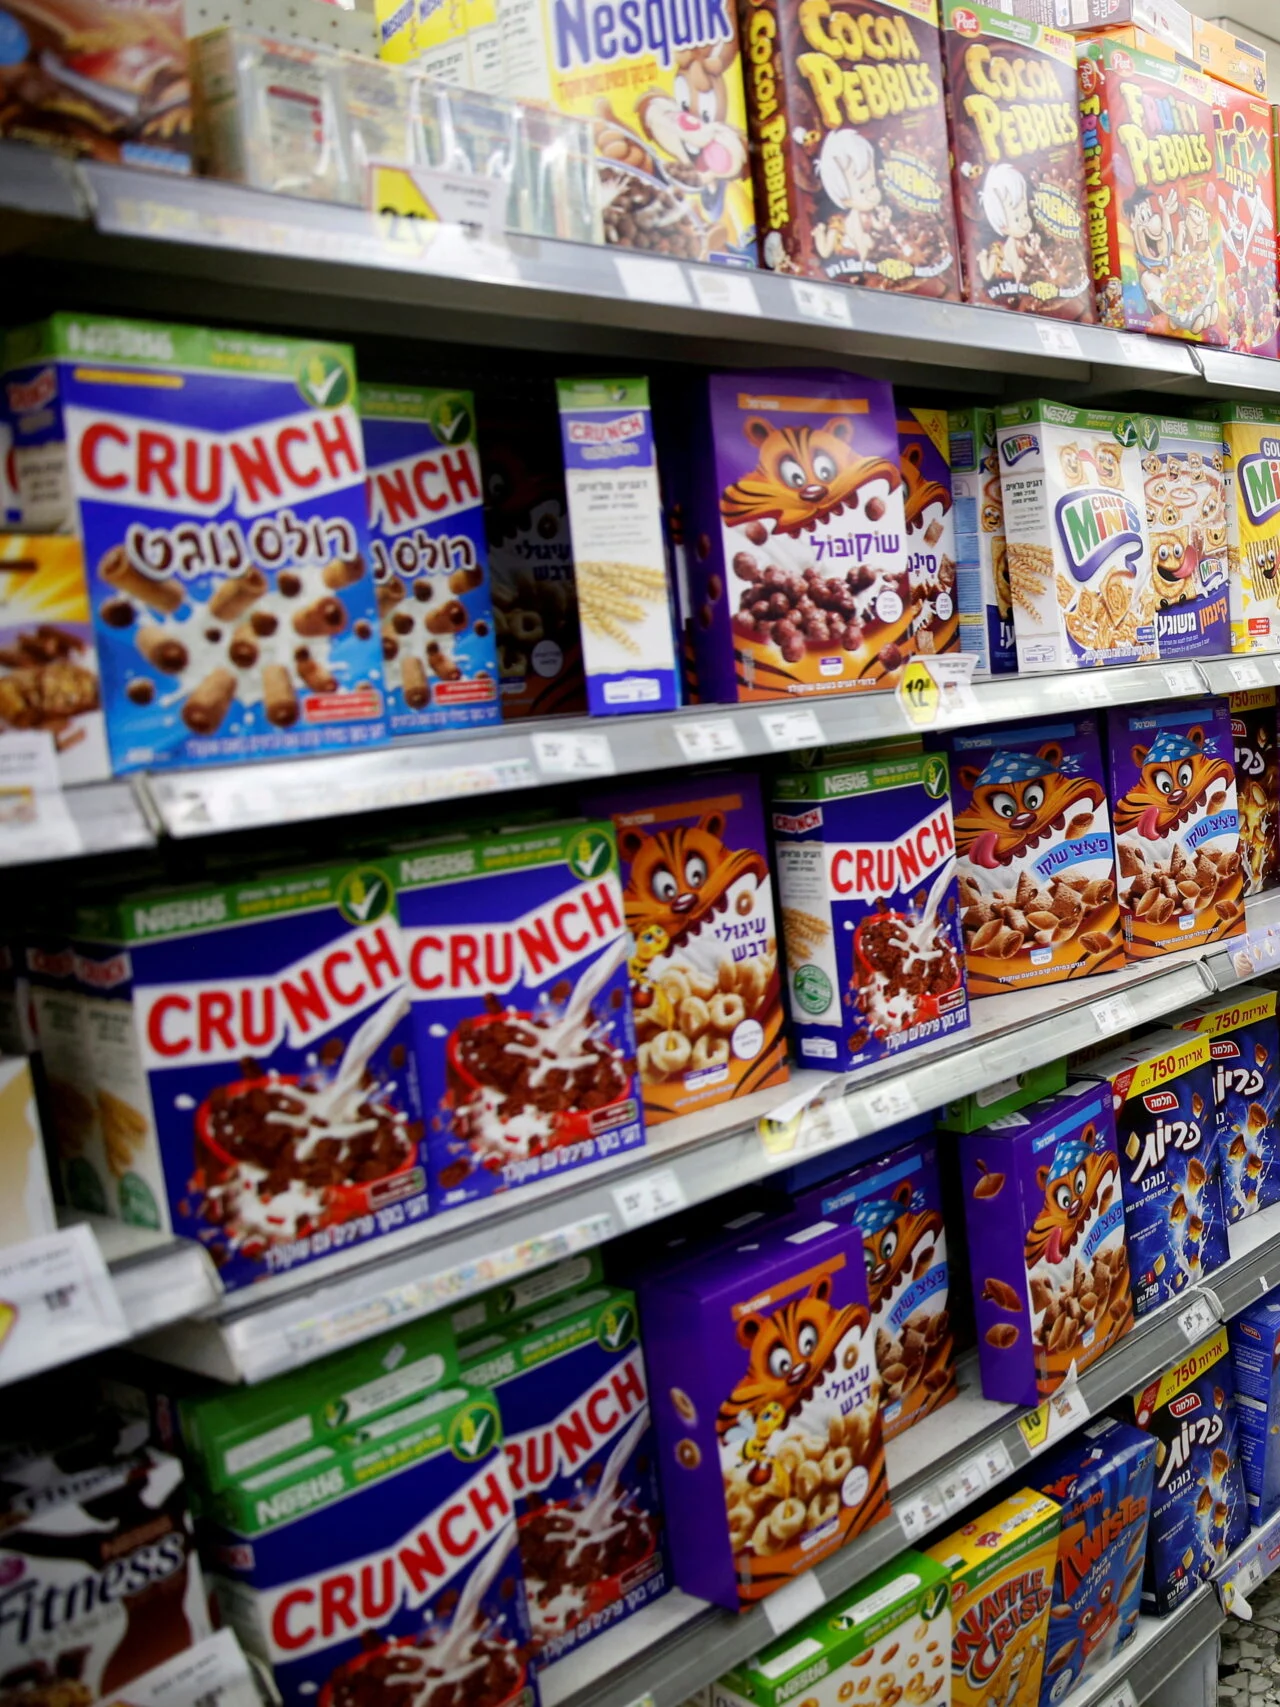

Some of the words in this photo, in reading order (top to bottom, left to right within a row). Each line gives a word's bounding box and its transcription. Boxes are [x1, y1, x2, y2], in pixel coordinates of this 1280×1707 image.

[801, 0, 922, 61] COCOA
[965, 45, 1063, 99] COCOA
[796, 53, 940, 129] PEBBLES
[963, 95, 1079, 163] PEBBLES
[1119, 124, 1212, 186] PEBBLES
[760, 114, 790, 230] PEBBLES
[1087, 185, 1111, 281] PEBBLES
[79, 414, 360, 506] CRUNCH
[1065, 500, 1142, 561] MINIS
[1198, 598, 1229, 634] קינמון
[824, 770, 869, 794] Nestlé
[773, 808, 822, 831] CRUNCH
[830, 812, 954, 896] CRUNCH
[409, 882, 622, 991] CRUNCH
[714, 917, 767, 940] עיגולי
[732, 939, 769, 962] דבש
[146, 928, 401, 1057] CRUNCH
[1215, 1009, 1240, 1031] 750
[1241, 1004, 1268, 1021] אריזת
[1178, 1048, 1203, 1069] אריזת
[1212, 1044, 1233, 1055] תלמה
[1149, 1055, 1176, 1081] 750
[1150, 1095, 1172, 1108] תלמה
[1141, 1171, 1166, 1193] נוגט
[1144, 1283, 1159, 1298] 750
[1198, 1342, 1223, 1369] אריזת
[825, 1364, 870, 1398] עיגולי
[1172, 1356, 1197, 1387] 750
[840, 1385, 871, 1416] דבש
[1175, 1396, 1196, 1413] תלמה
[1168, 1469, 1191, 1495] נוגט
[272, 1473, 510, 1652] CRUNCH
[1174, 1575, 1189, 1593] 750
[952, 1567, 1046, 1665] WAFFLE
[972, 1584, 1052, 1677] CRISP
